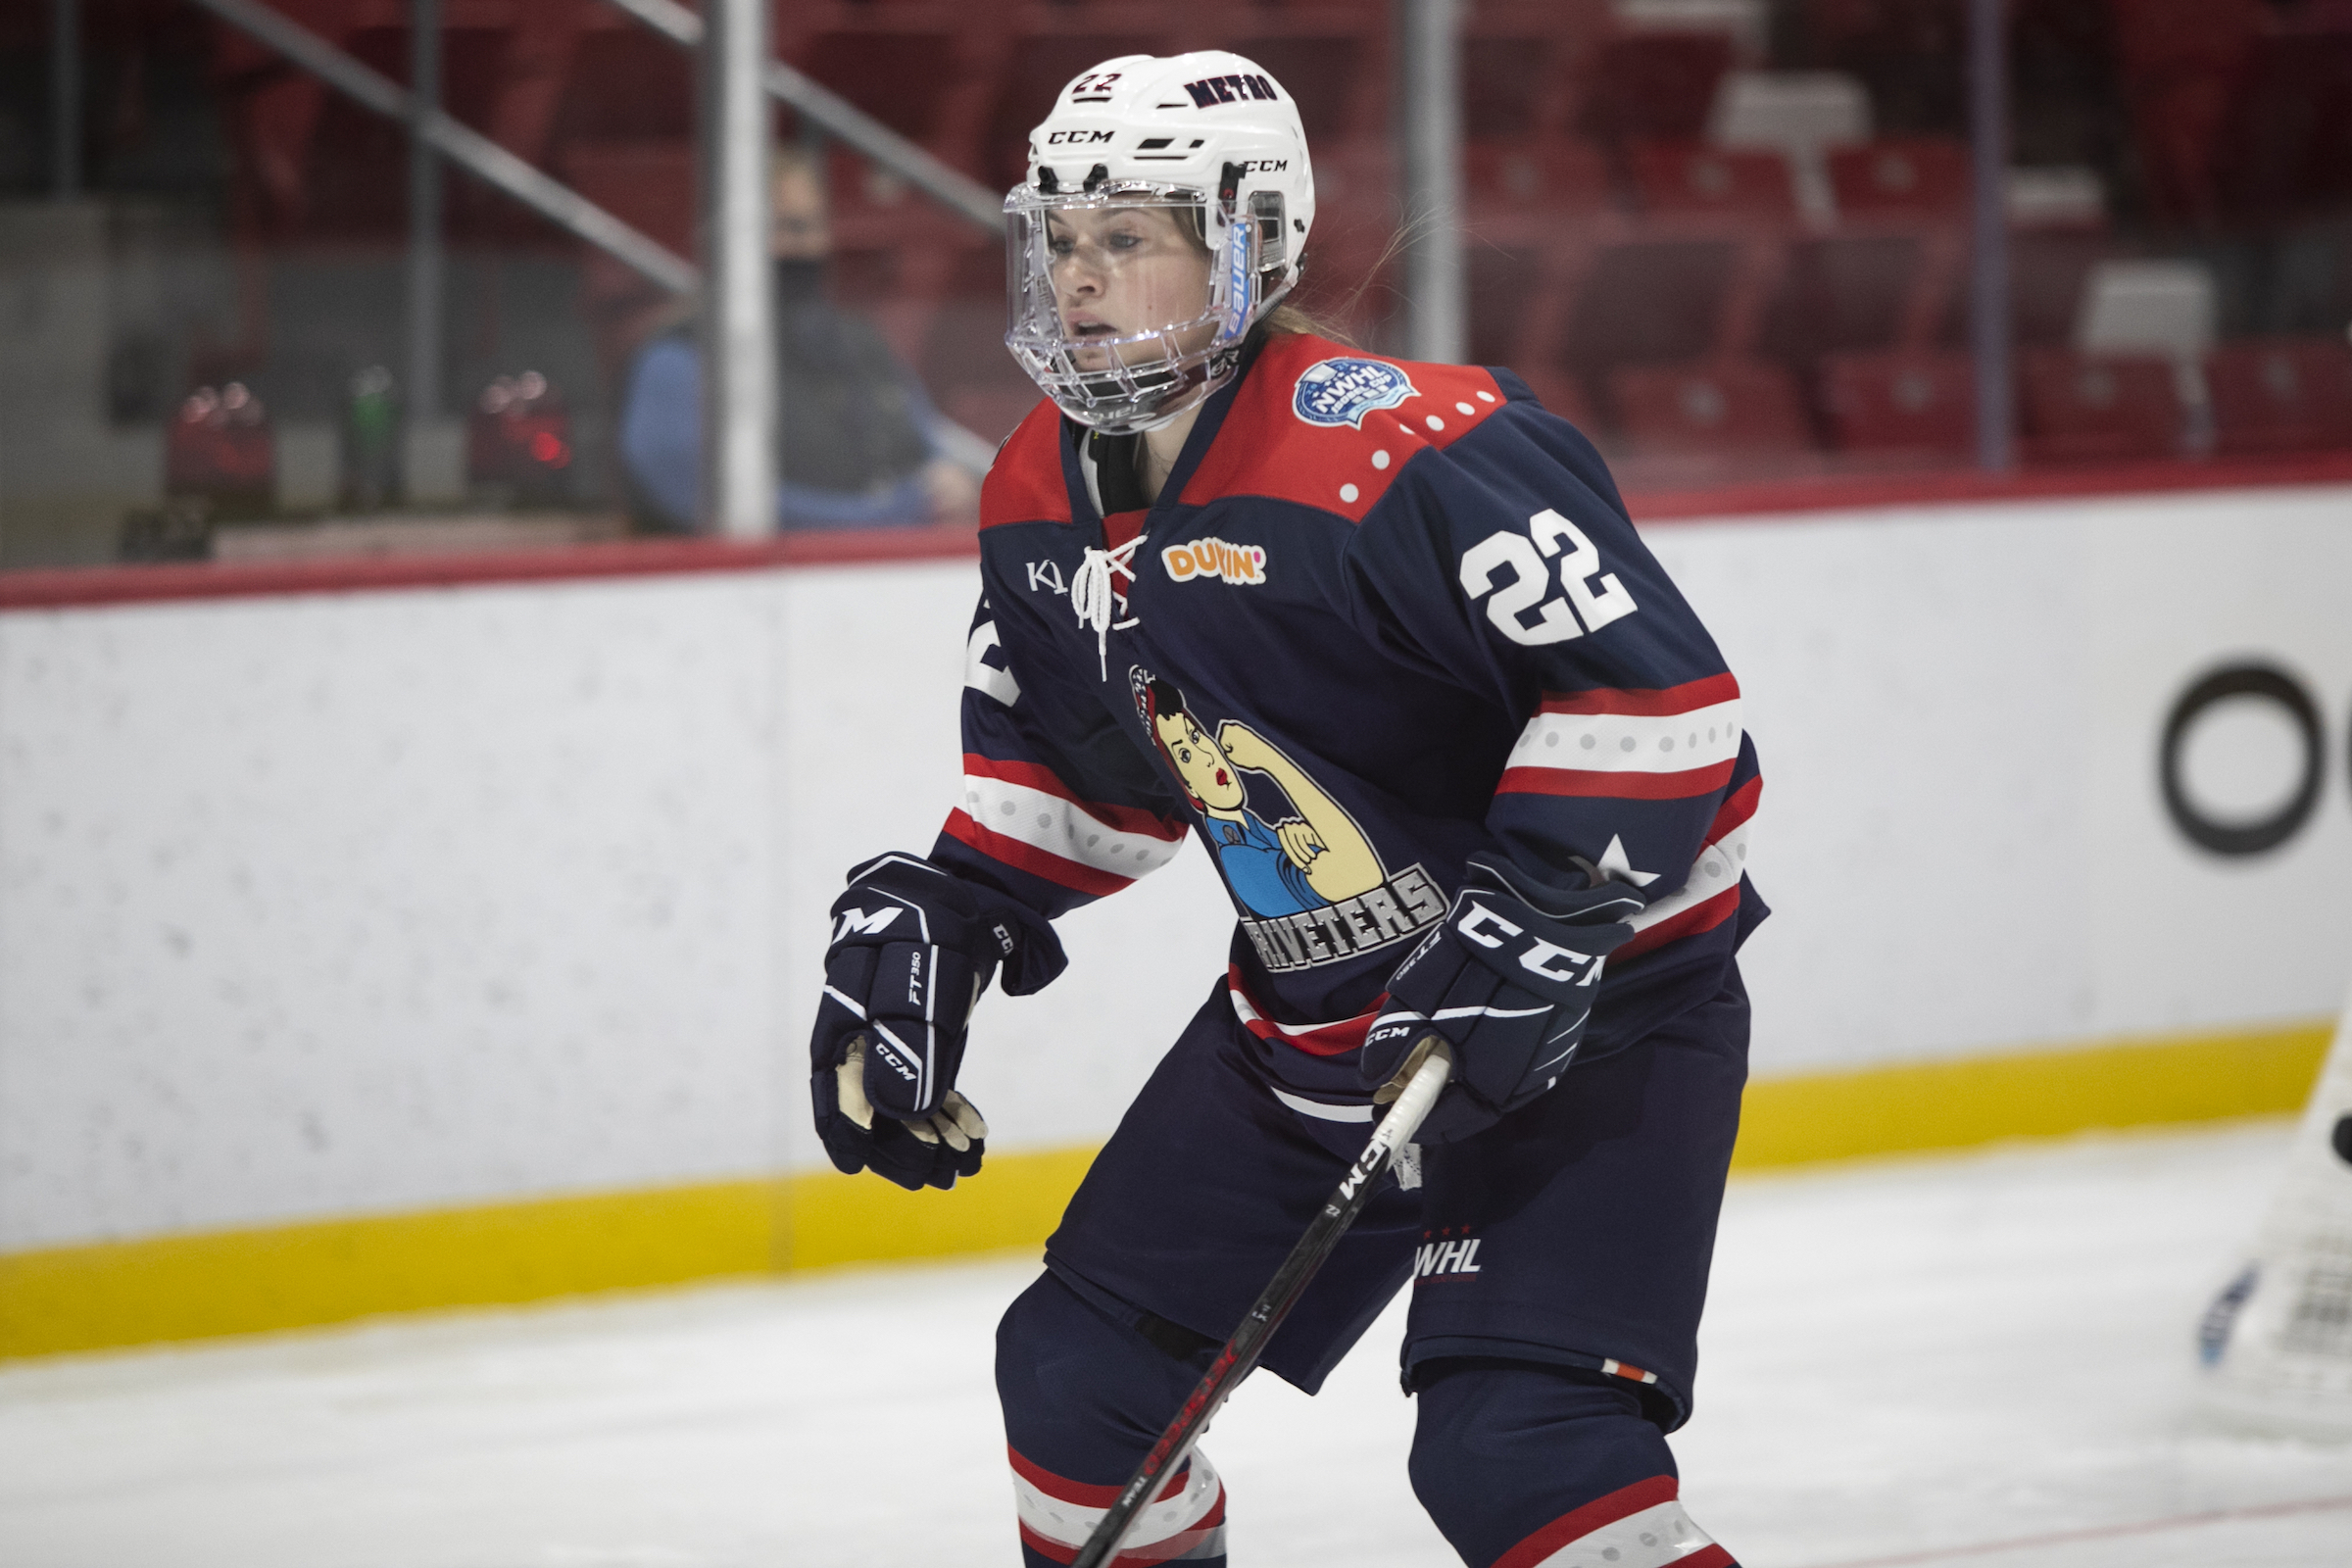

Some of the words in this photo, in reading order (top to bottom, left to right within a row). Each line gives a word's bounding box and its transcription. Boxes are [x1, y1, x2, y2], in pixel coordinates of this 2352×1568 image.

[1072, 74, 1122, 95] 22
[1184, 74, 1278, 110] METRO
[1048, 130, 1115, 145] CCM
[1243, 160, 1288, 172] CCM
[1315, 366, 1386, 414] NWHL
[1369, 373, 1393, 388] CUP
[1460, 509, 1638, 645] 22
[2159, 655, 2352, 866] O
[908, 952, 921, 1006] FT350
[1364, 1026, 1410, 1048] CCM
[875, 1042, 916, 1081] CCM
